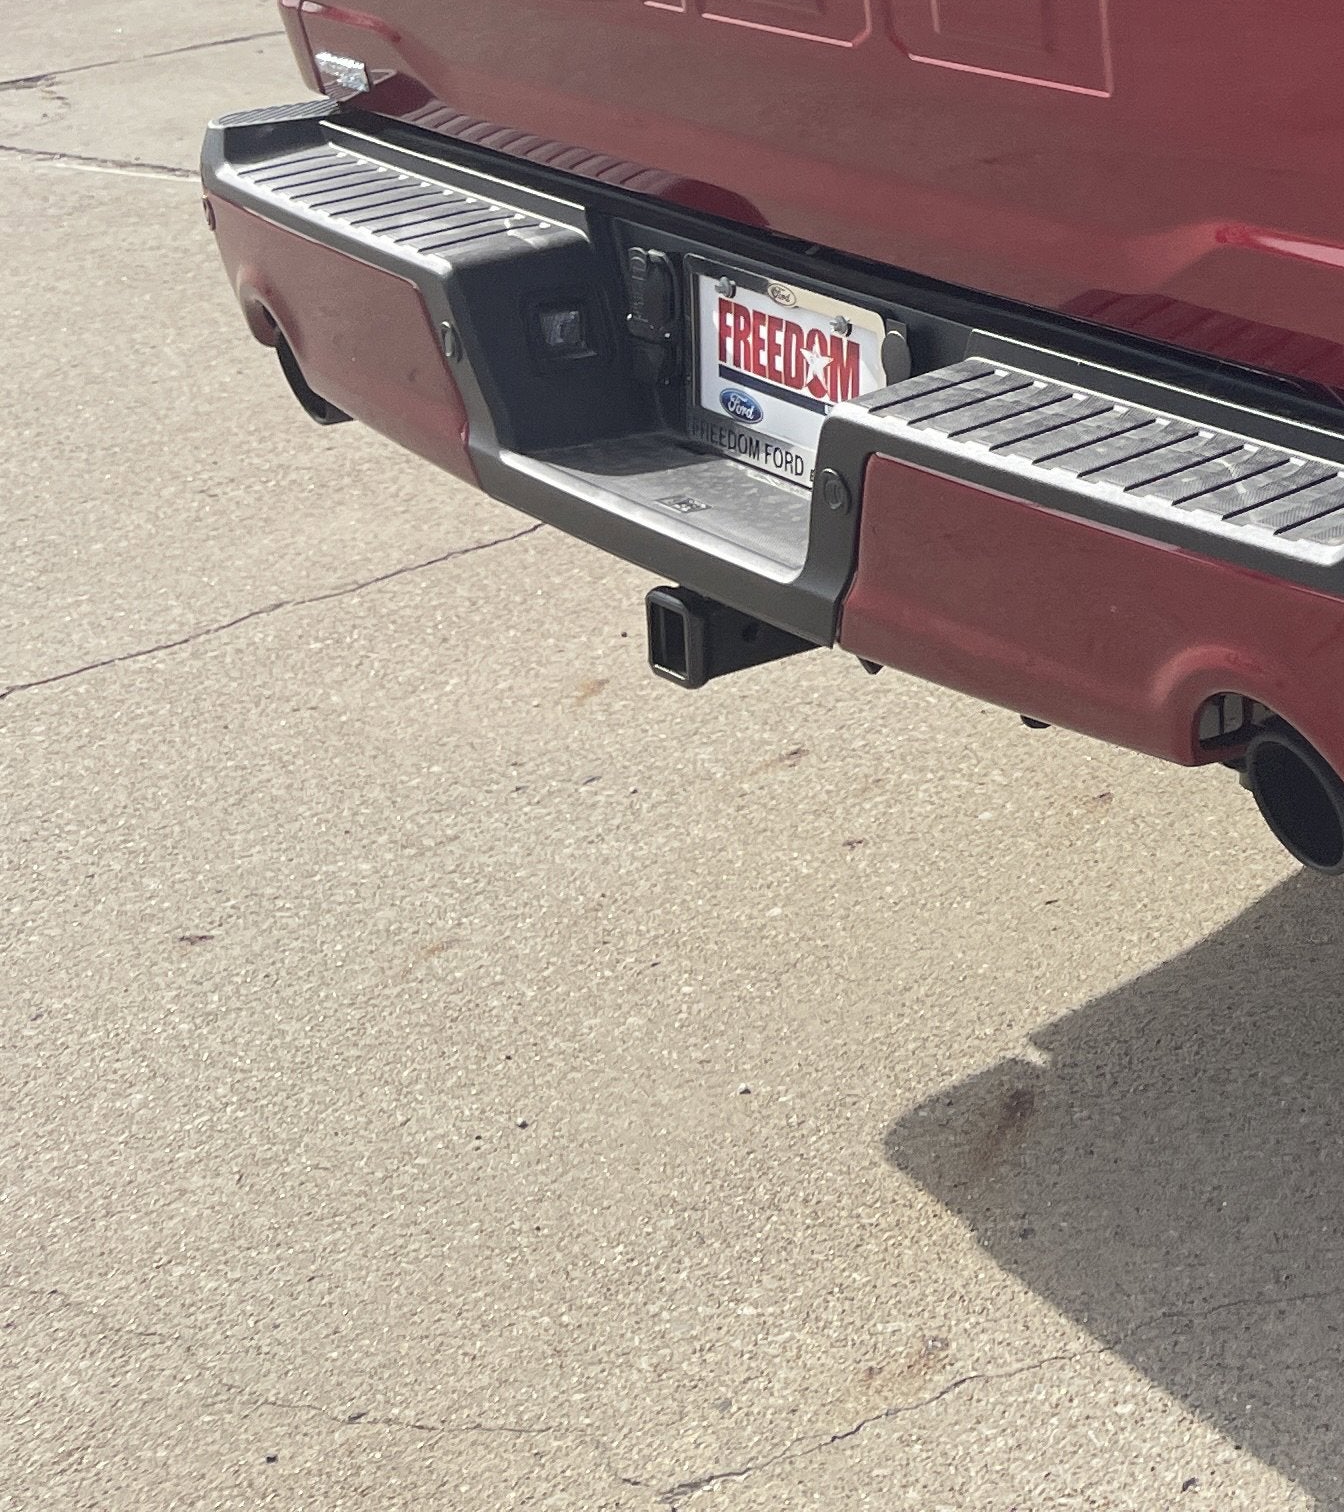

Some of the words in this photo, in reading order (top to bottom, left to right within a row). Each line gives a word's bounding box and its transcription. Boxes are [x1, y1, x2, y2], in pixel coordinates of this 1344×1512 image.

[770, 286, 791, 303] Ford
[718, 297, 861, 404] FREEDOM
[726, 393, 756, 421] Ford
[764, 443, 805, 476] FORD
